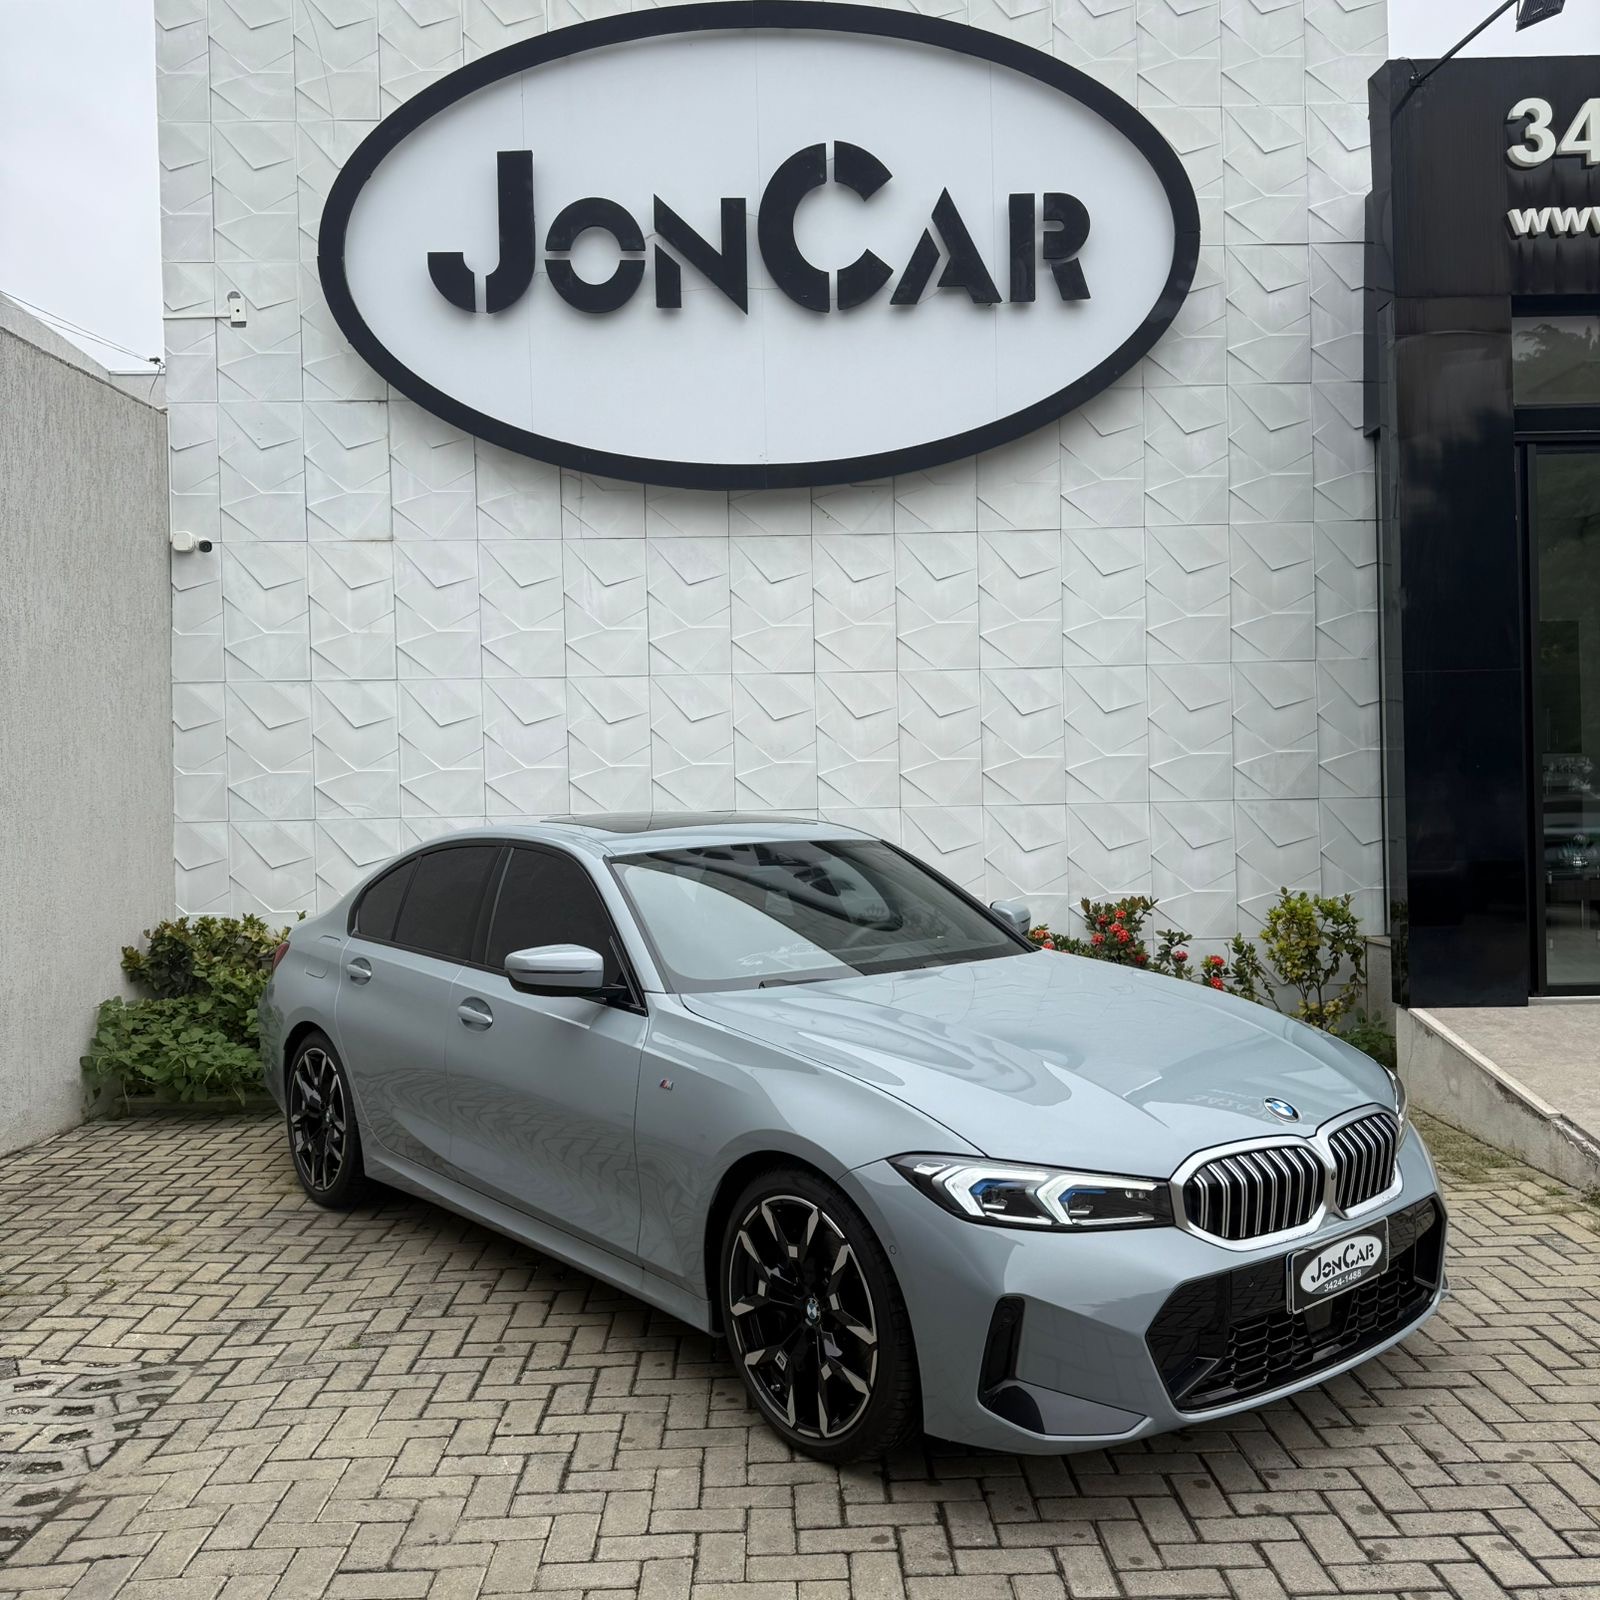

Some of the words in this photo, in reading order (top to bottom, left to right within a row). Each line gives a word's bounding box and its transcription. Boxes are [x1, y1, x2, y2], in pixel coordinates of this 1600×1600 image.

[1507, 97, 1600, 167] 34
[1507, 206, 1600, 235] ww
[1324, 1269, 1362, 1292] 3424-1488
